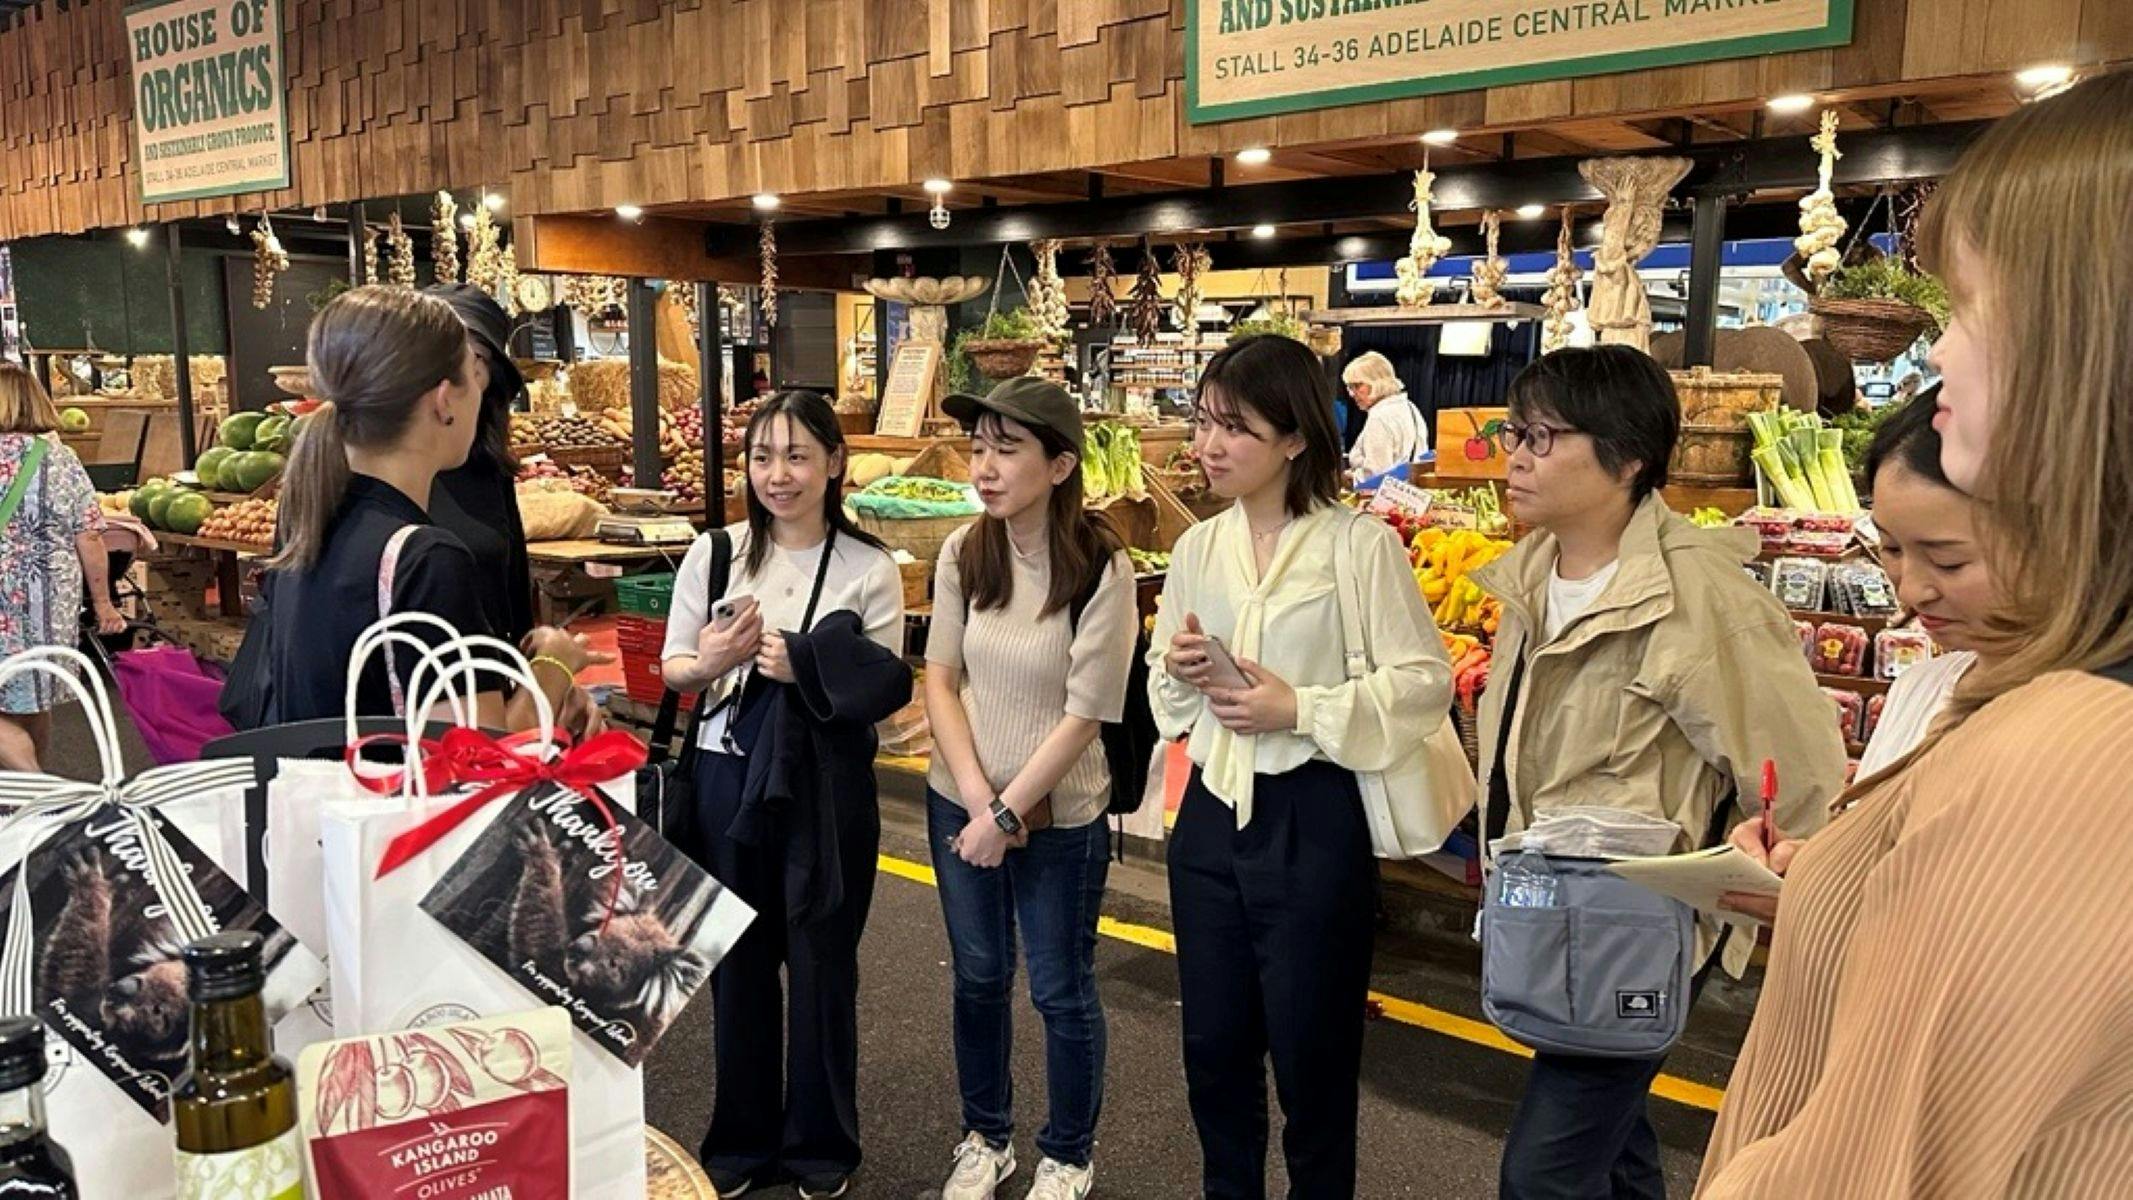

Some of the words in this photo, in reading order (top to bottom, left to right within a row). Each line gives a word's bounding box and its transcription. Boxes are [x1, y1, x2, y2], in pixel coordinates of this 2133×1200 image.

[134, 9, 217, 62] HOUSE
[231, 0, 268, 37] OF
[1219, 0, 1272, 34] AND
[1215, 51, 1285, 79] STALL
[1294, 38, 1358, 69] 34-36
[1368, 17, 1501, 58] ADELAIDE
[1513, 1, 1650, 38] CENTRAL
[140, 44, 273, 133] ORGANICS
[391, 1130, 499, 1168] KANGAROO
[413, 1148, 480, 1176] ISLAND
[417, 1170, 478, 1199] OLIVES
